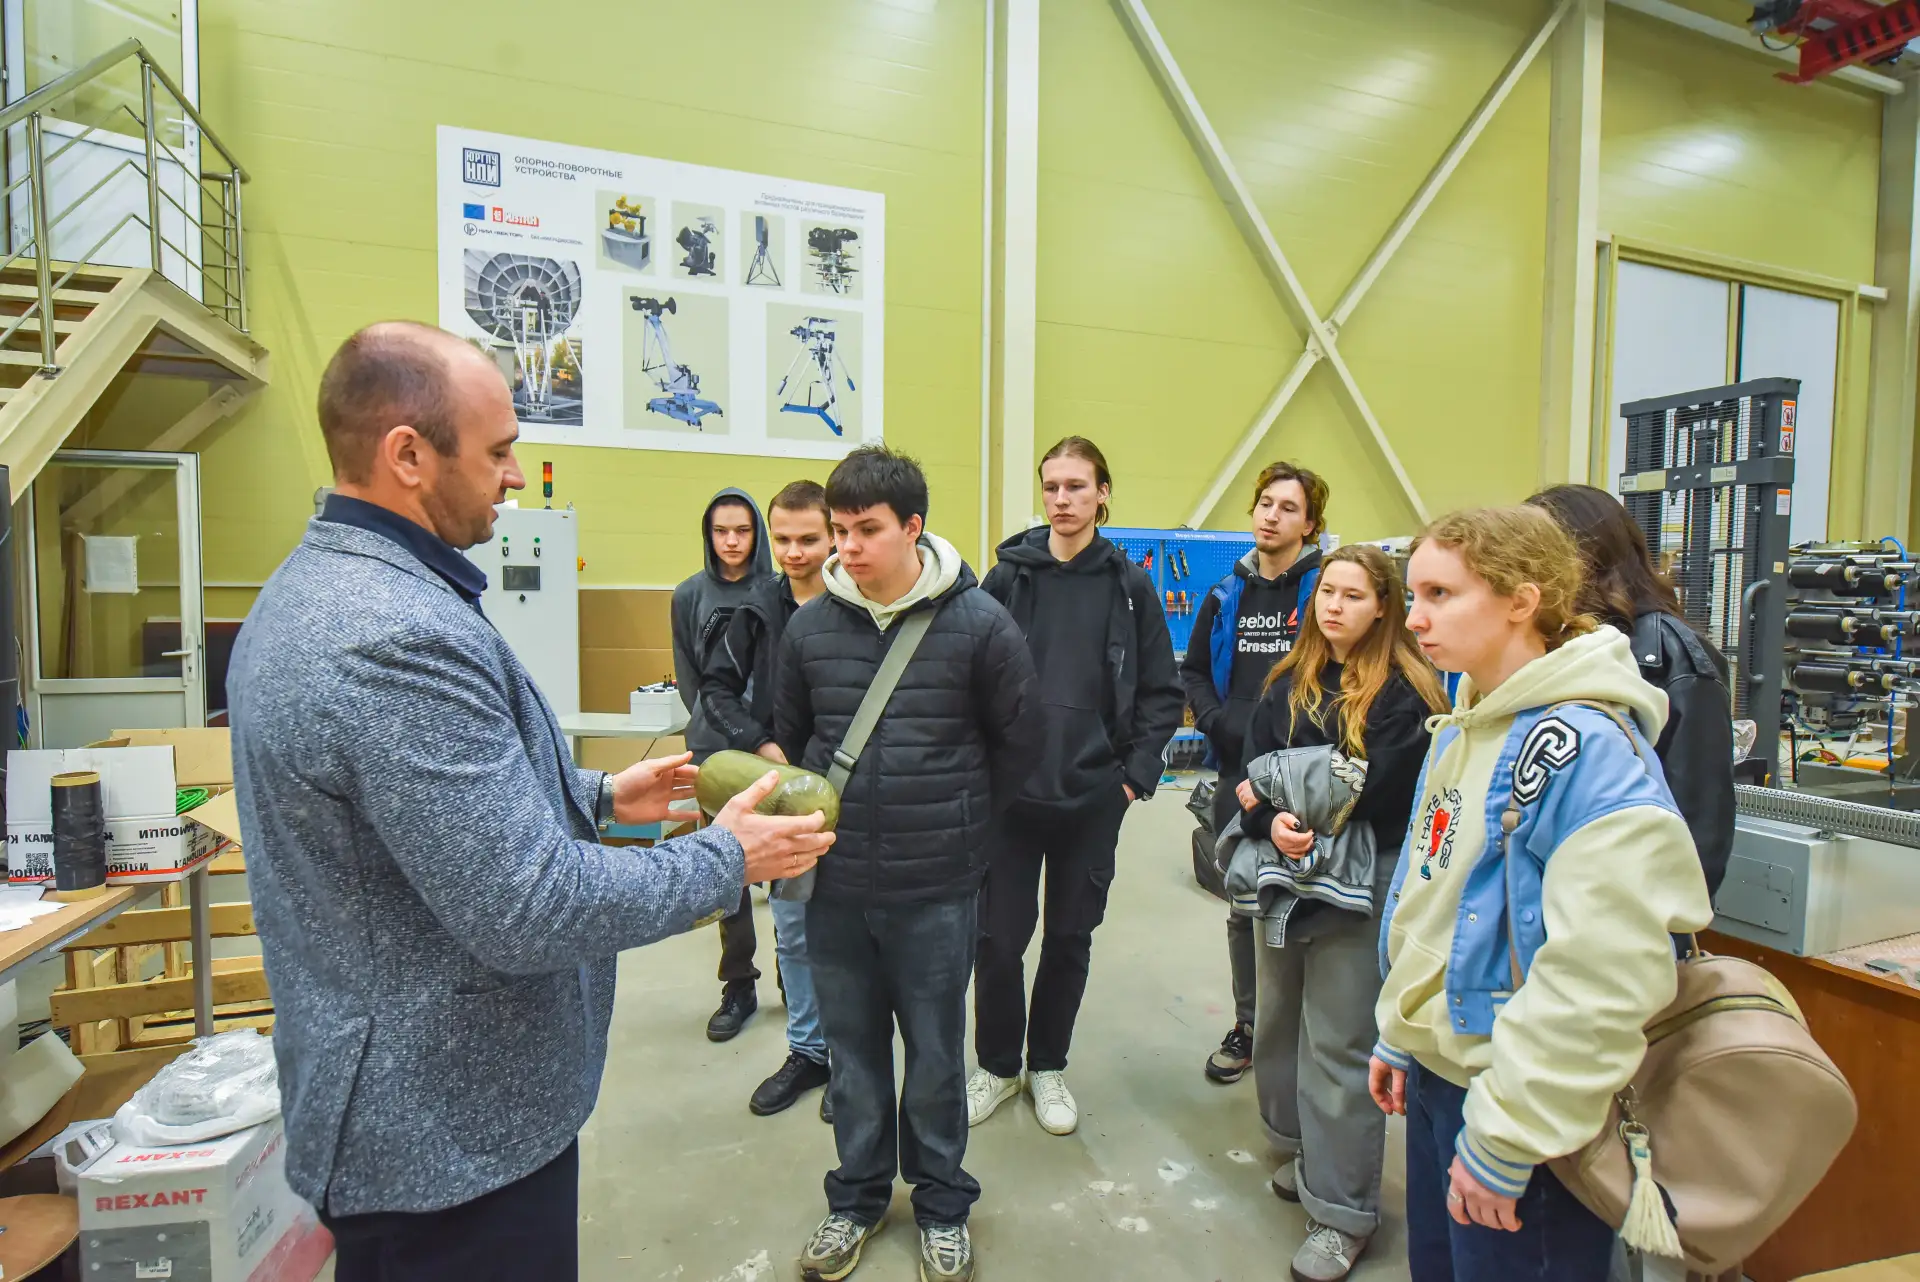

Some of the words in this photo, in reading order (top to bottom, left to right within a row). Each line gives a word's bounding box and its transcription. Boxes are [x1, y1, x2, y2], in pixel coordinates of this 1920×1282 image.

[466, 151, 497, 165] ЮРГПУ
[514, 155, 623, 179] ОПОРНО-ПОВОРОТНЫЕ
[466, 161, 498, 184] НПИ
[514, 165, 577, 181] УСТРОЙСТВА
[1238, 611, 1287, 629] eebok
[1238, 638, 1292, 653] CrossFit
[1512, 716, 1582, 807] C
[116, 1148, 216, 1164] REXANT
[95, 1188, 208, 1212] REXANT
